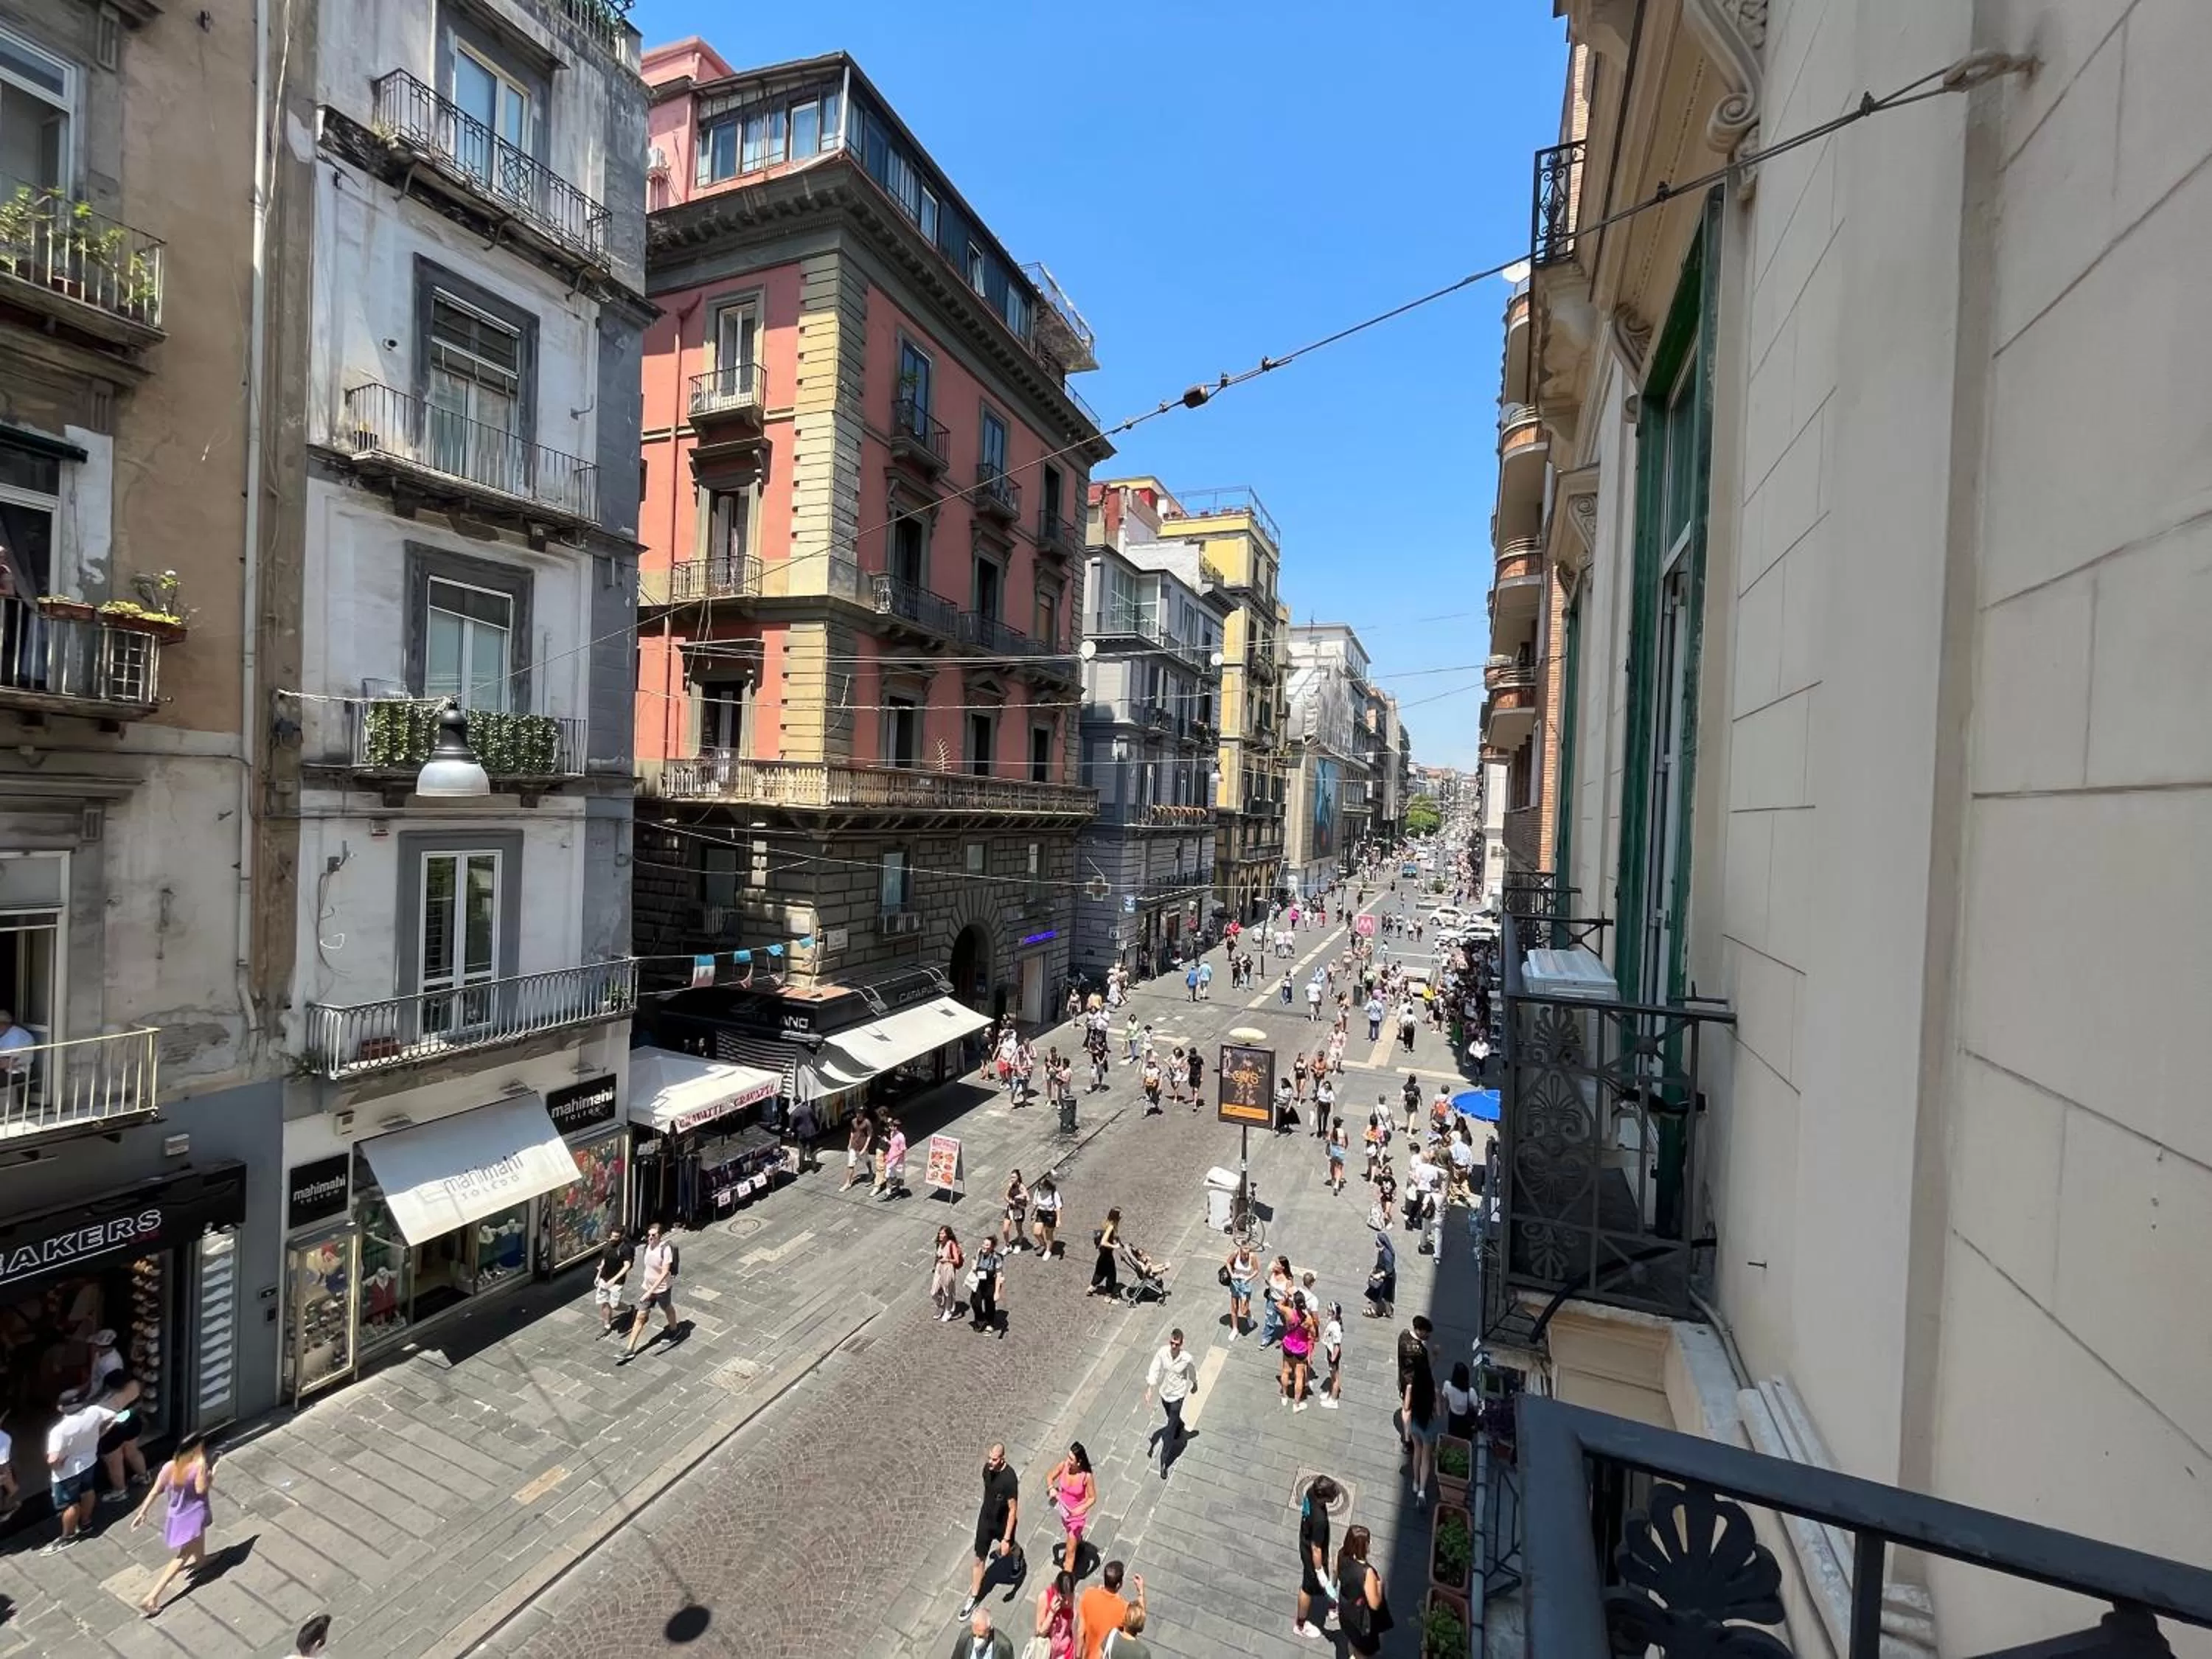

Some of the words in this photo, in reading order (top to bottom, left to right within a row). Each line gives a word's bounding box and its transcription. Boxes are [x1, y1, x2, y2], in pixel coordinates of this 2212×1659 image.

[552, 1086, 613, 1119] mahimahi
[293, 1173, 346, 1202] mahimahi
[443, 1151, 524, 1193] mahimahi
